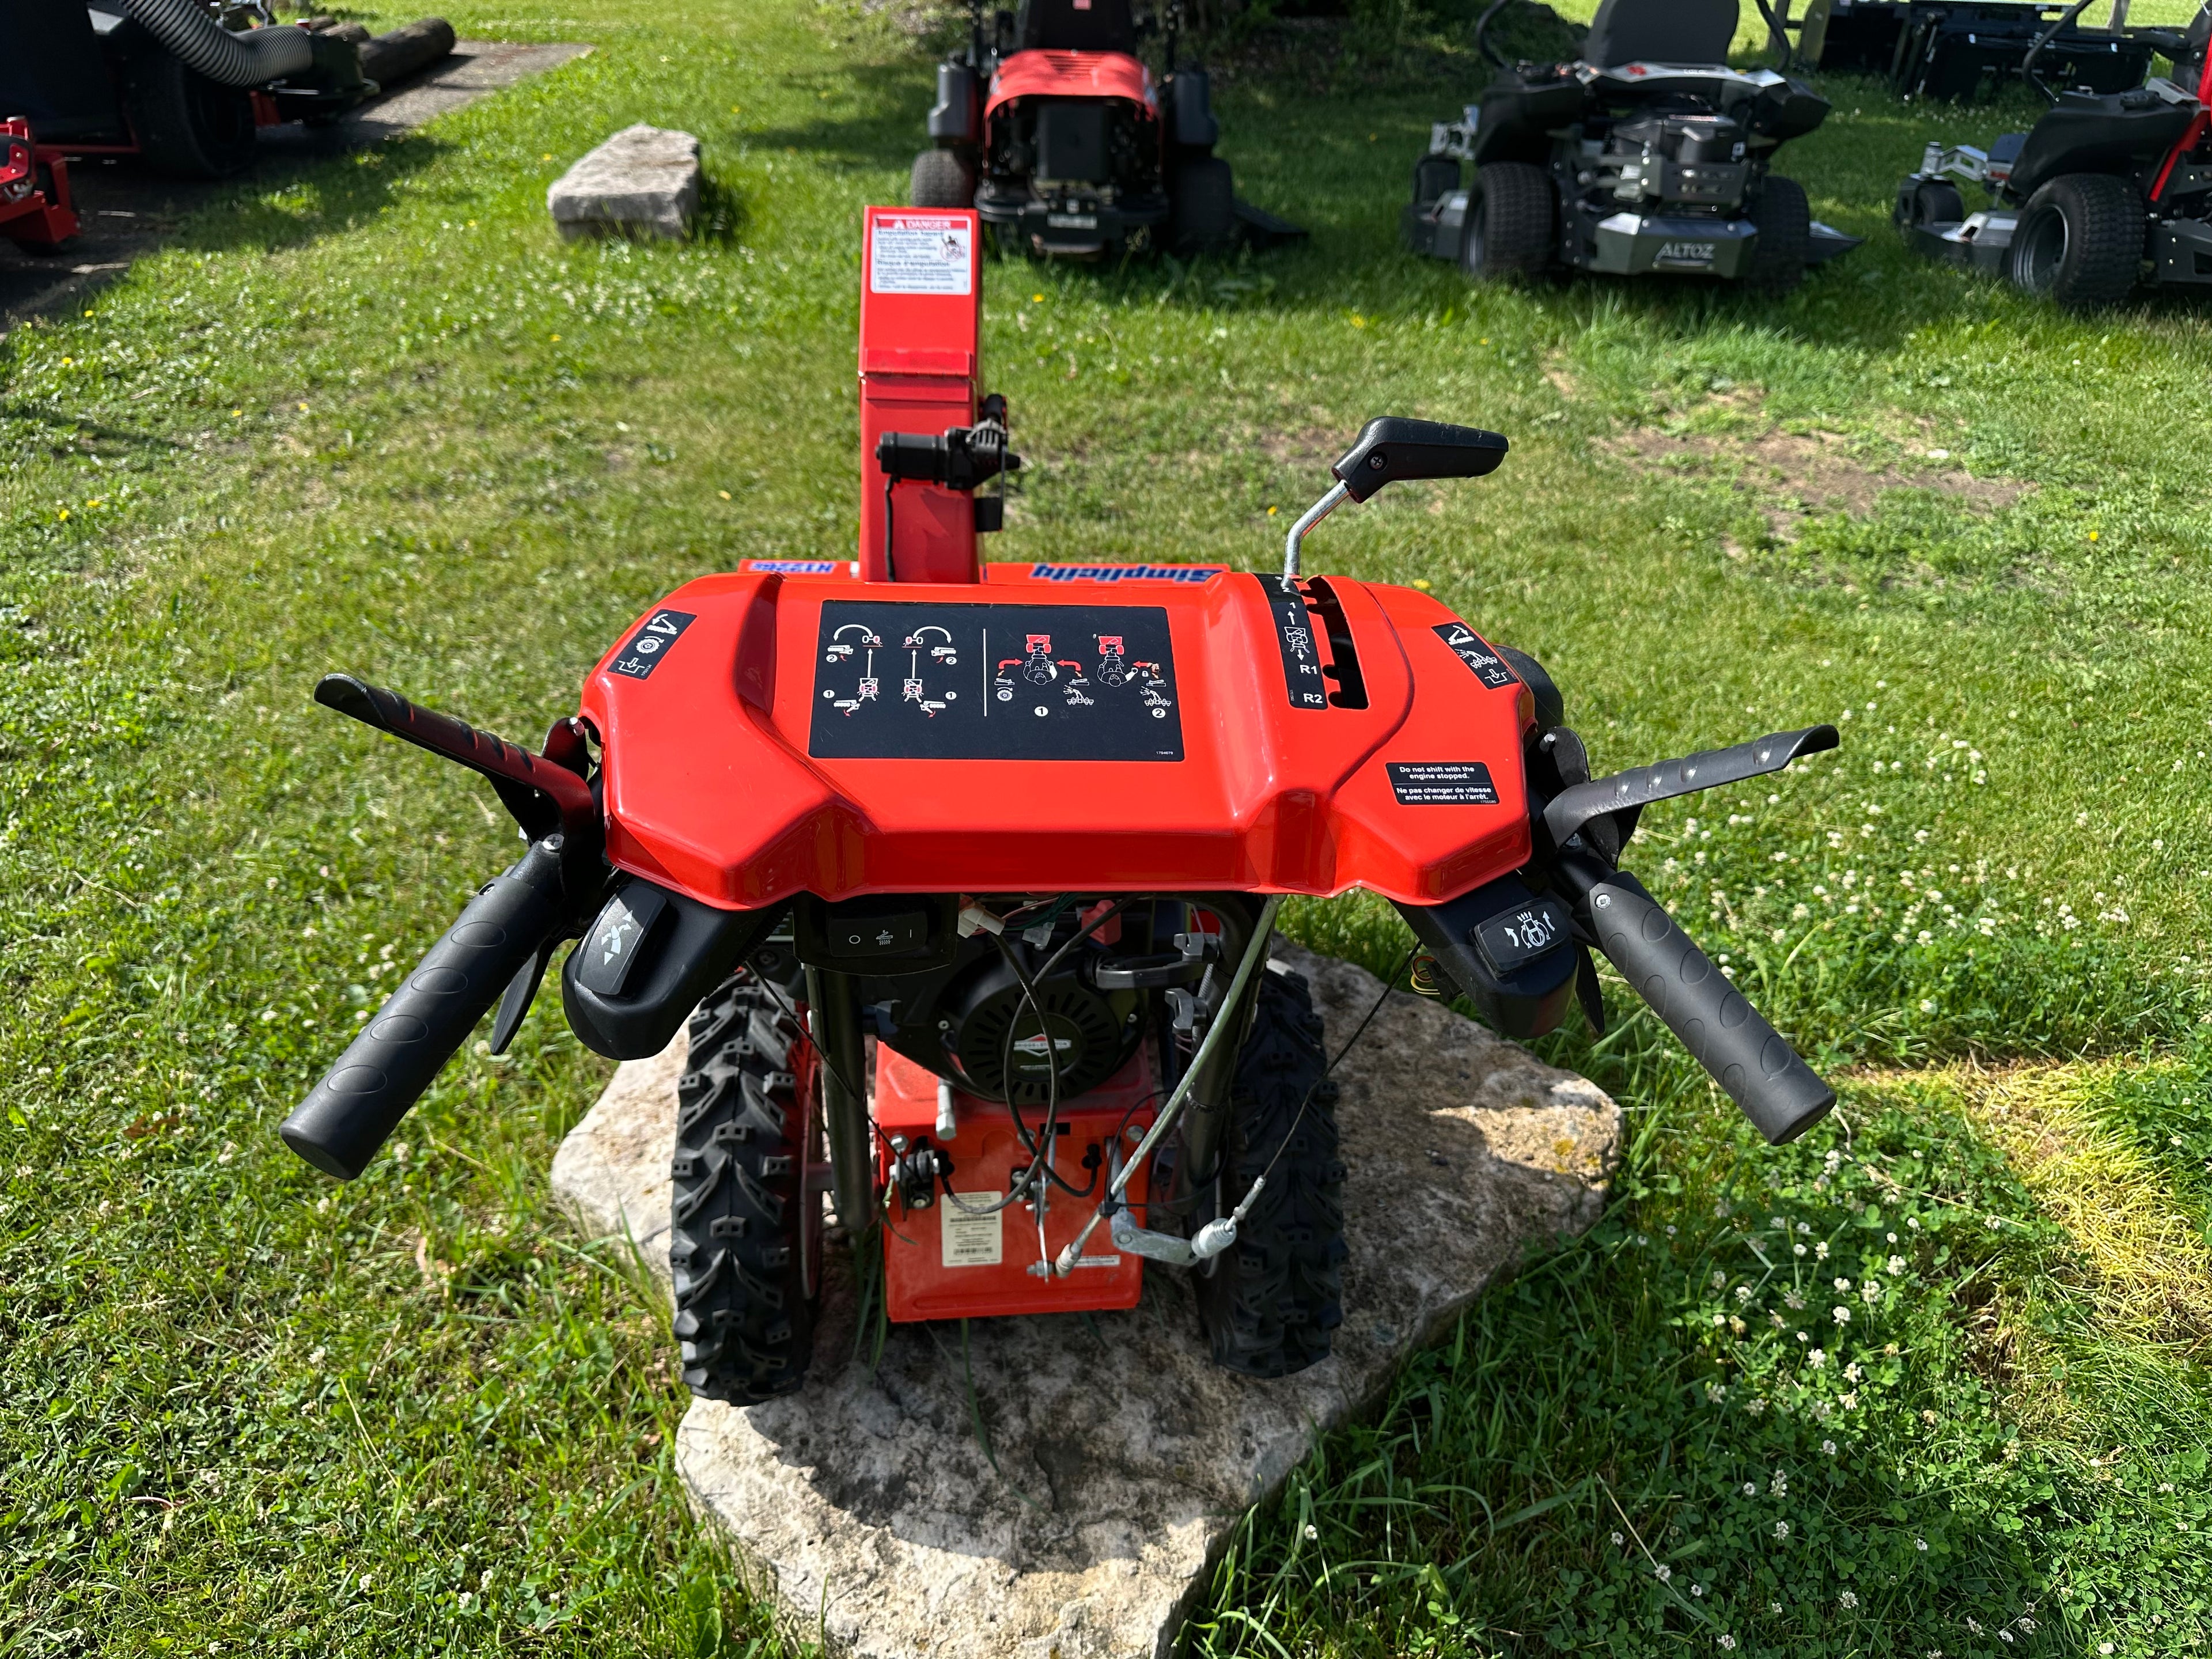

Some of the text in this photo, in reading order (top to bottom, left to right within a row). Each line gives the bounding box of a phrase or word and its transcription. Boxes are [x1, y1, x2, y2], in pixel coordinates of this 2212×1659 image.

[906, 220, 951, 229] DANGER
[1655, 241, 1716, 260] ALTOZ
[1031, 564, 1223, 582] Simplicity
[1299, 664, 1318, 675] R1
[1303, 693, 1324, 704] R2
